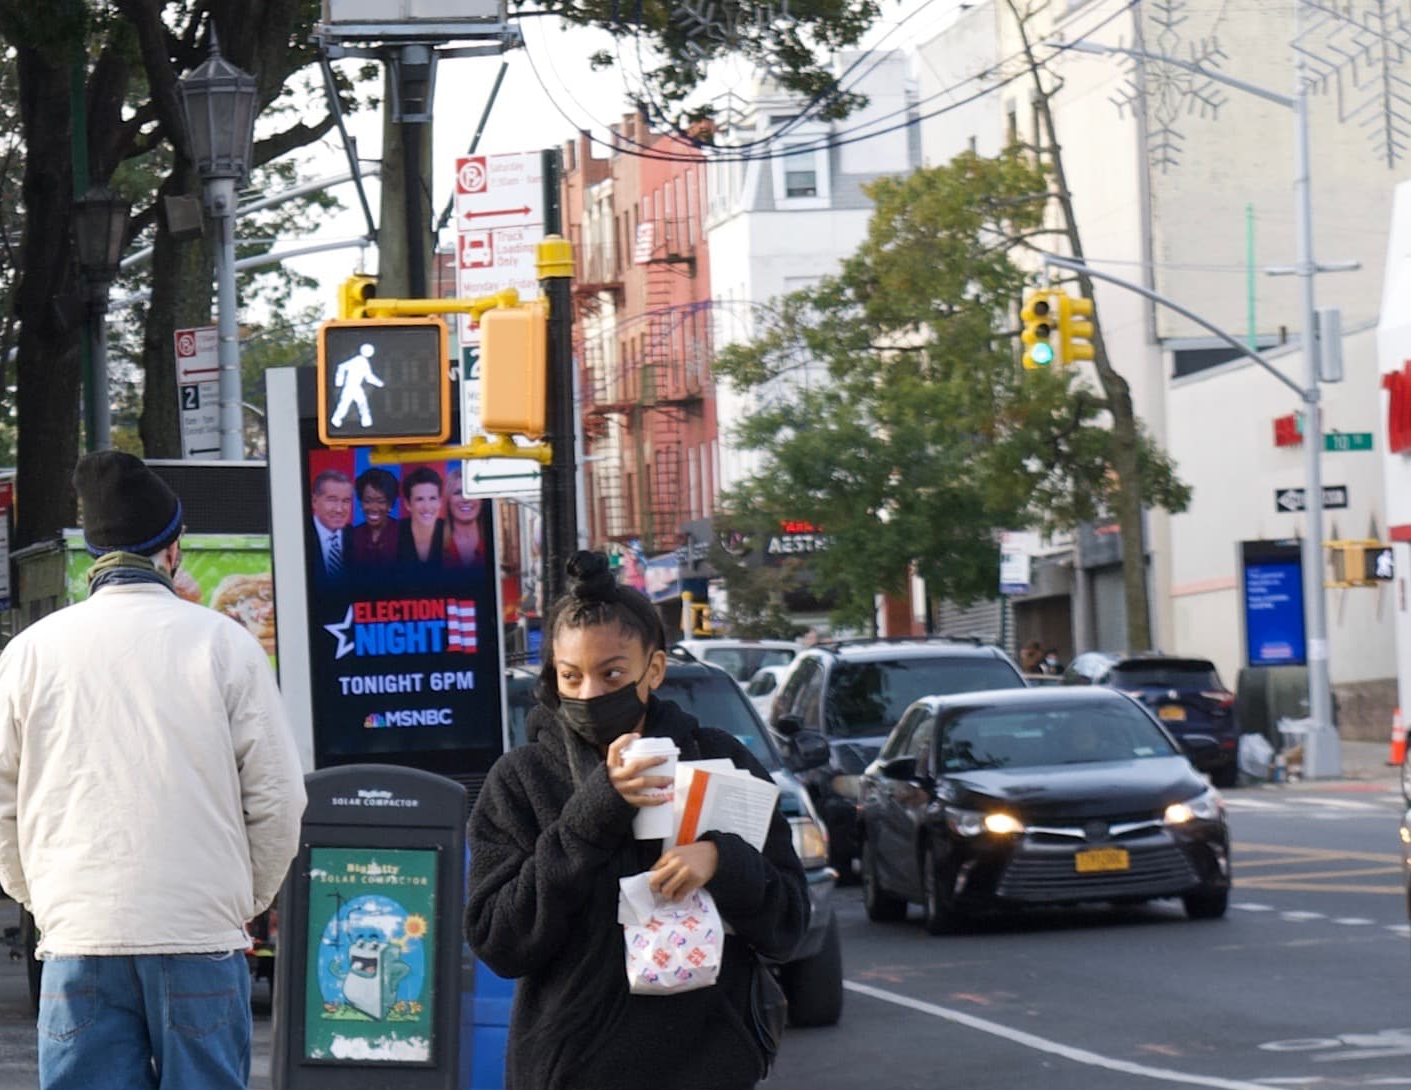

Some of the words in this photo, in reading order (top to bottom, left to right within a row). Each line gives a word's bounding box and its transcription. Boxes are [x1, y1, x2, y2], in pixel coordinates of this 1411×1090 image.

[185, 388, 195, 408] 2
[354, 599, 445, 623] ELECTION
[355, 620, 445, 656] NIGHT
[339, 673, 424, 695] TONIGHT
[430, 671, 474, 691] 6PM
[385, 708, 452, 727] MSNBC
[332, 798, 361, 806] SOLAR
[363, 798, 419, 807] COMPACTOR
